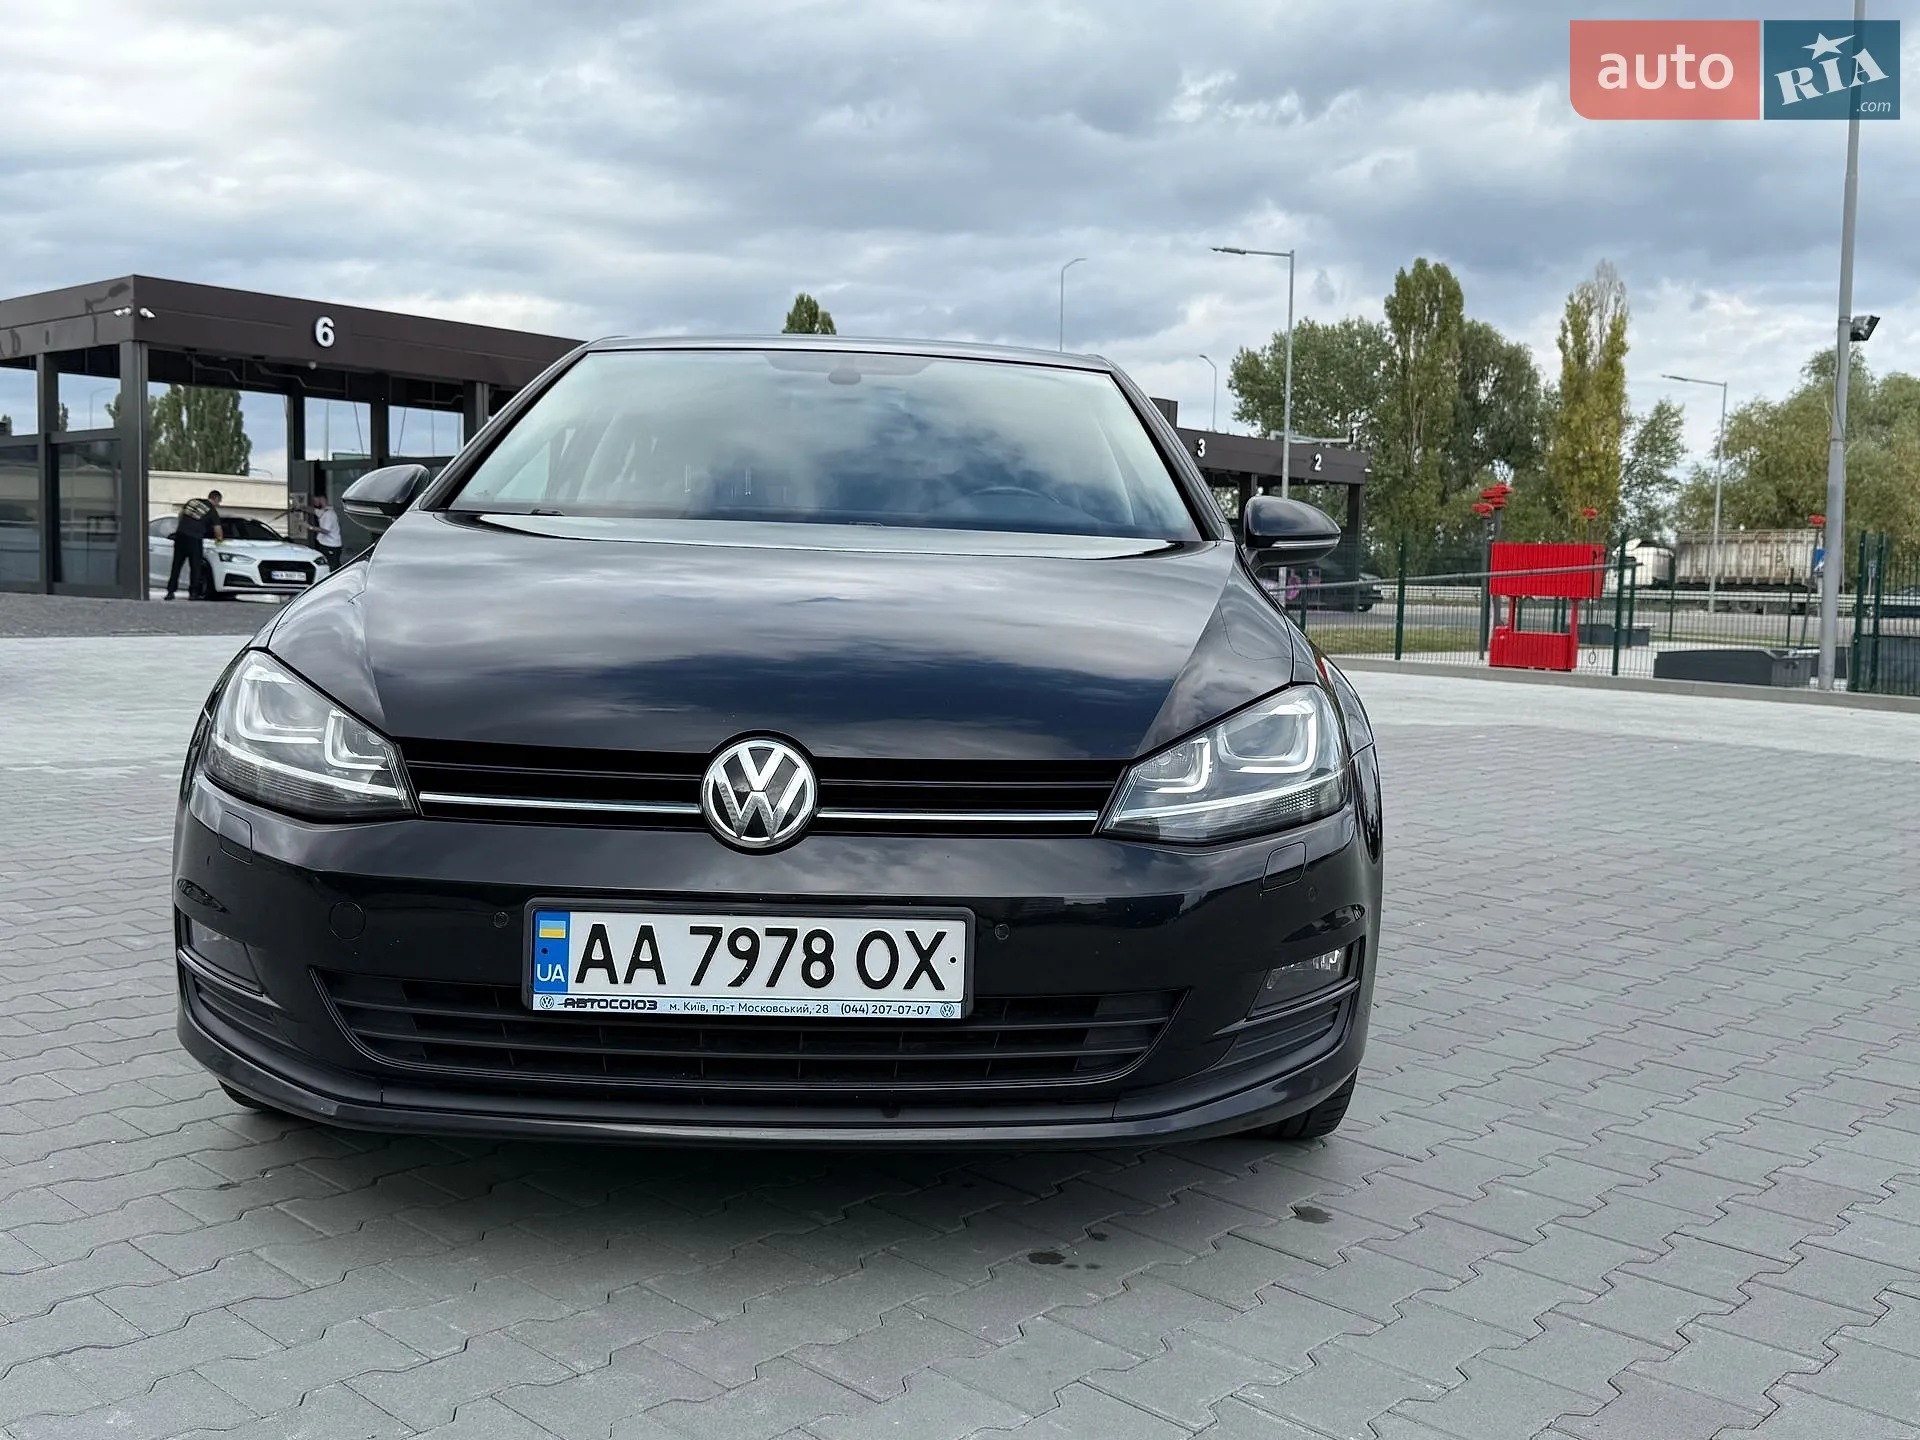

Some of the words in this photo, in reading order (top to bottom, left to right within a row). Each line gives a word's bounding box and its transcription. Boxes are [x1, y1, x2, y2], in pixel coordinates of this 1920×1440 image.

[314, 316, 335, 348] 6
[1196, 438, 1206, 458] 3
[1313, 453, 1322, 472] 2
[574, 923, 667, 986] AA
[688, 925, 836, 990] 7978
[856, 930, 948, 992] OX
[536, 963, 566, 984] UA
[558, 997, 658, 1011] АВТОСОЮЗ
[669, 1003, 680, 1012] м.
[683, 1001, 709, 1013] Київ,
[712, 1004, 734, 1014] пр-т
[738, 1003, 812, 1015] Московський,
[815, 1004, 829, 1014] 28
[841, 1004, 869, 1015] (044)
[871, 1005, 931, 1016] 207-07-07
